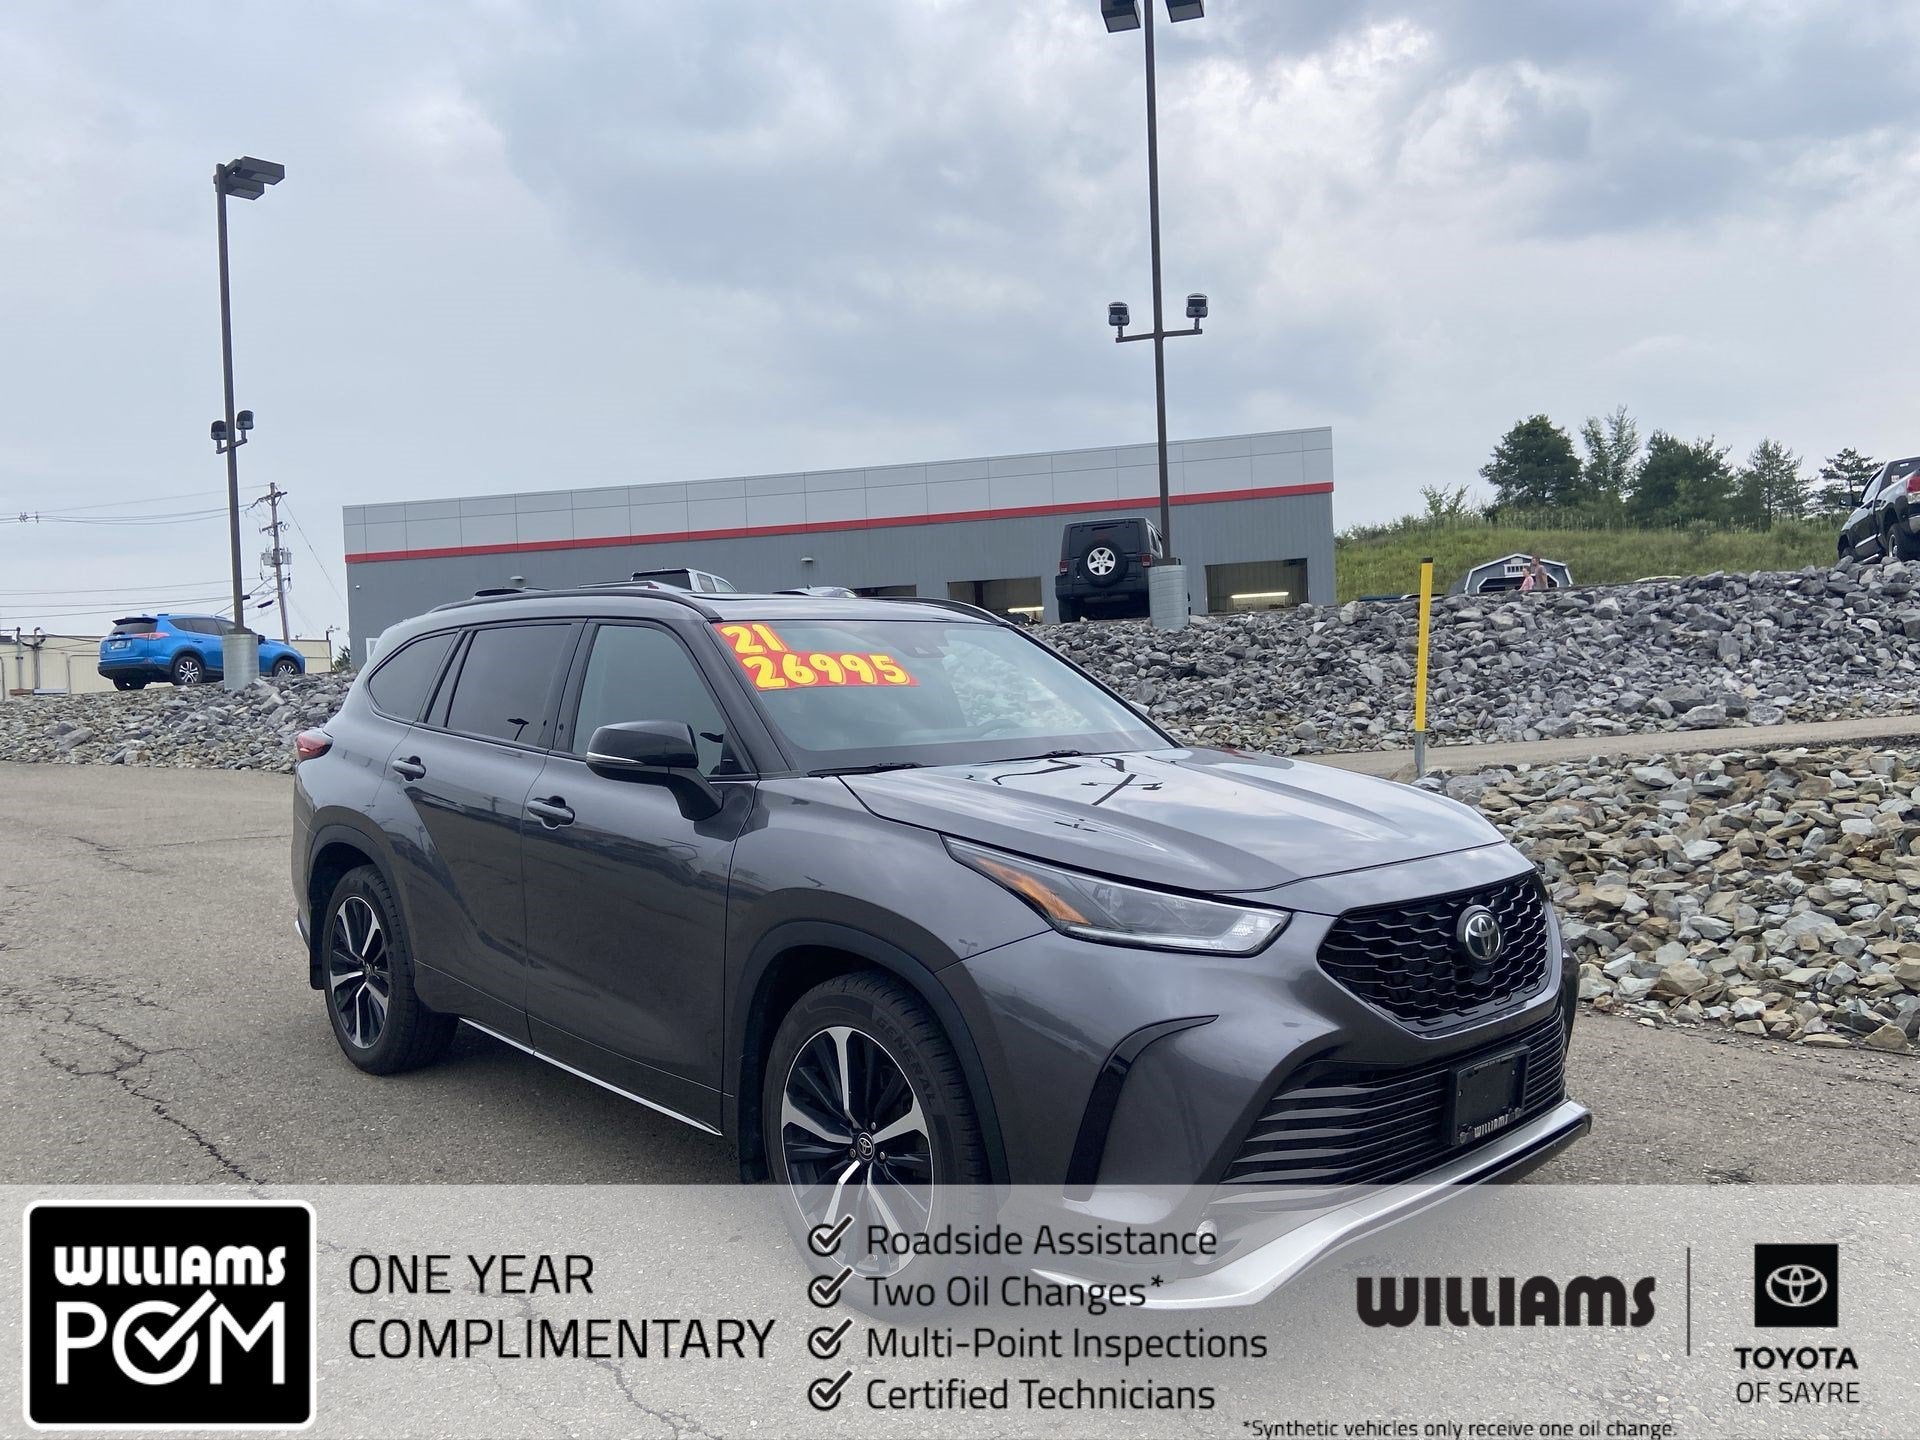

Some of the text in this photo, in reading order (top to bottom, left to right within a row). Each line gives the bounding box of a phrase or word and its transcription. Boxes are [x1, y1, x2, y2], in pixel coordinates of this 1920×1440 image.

[720, 624, 788, 654] 21
[741, 653, 910, 688] 26995
[876, 1016, 935, 1106] GENERAL
